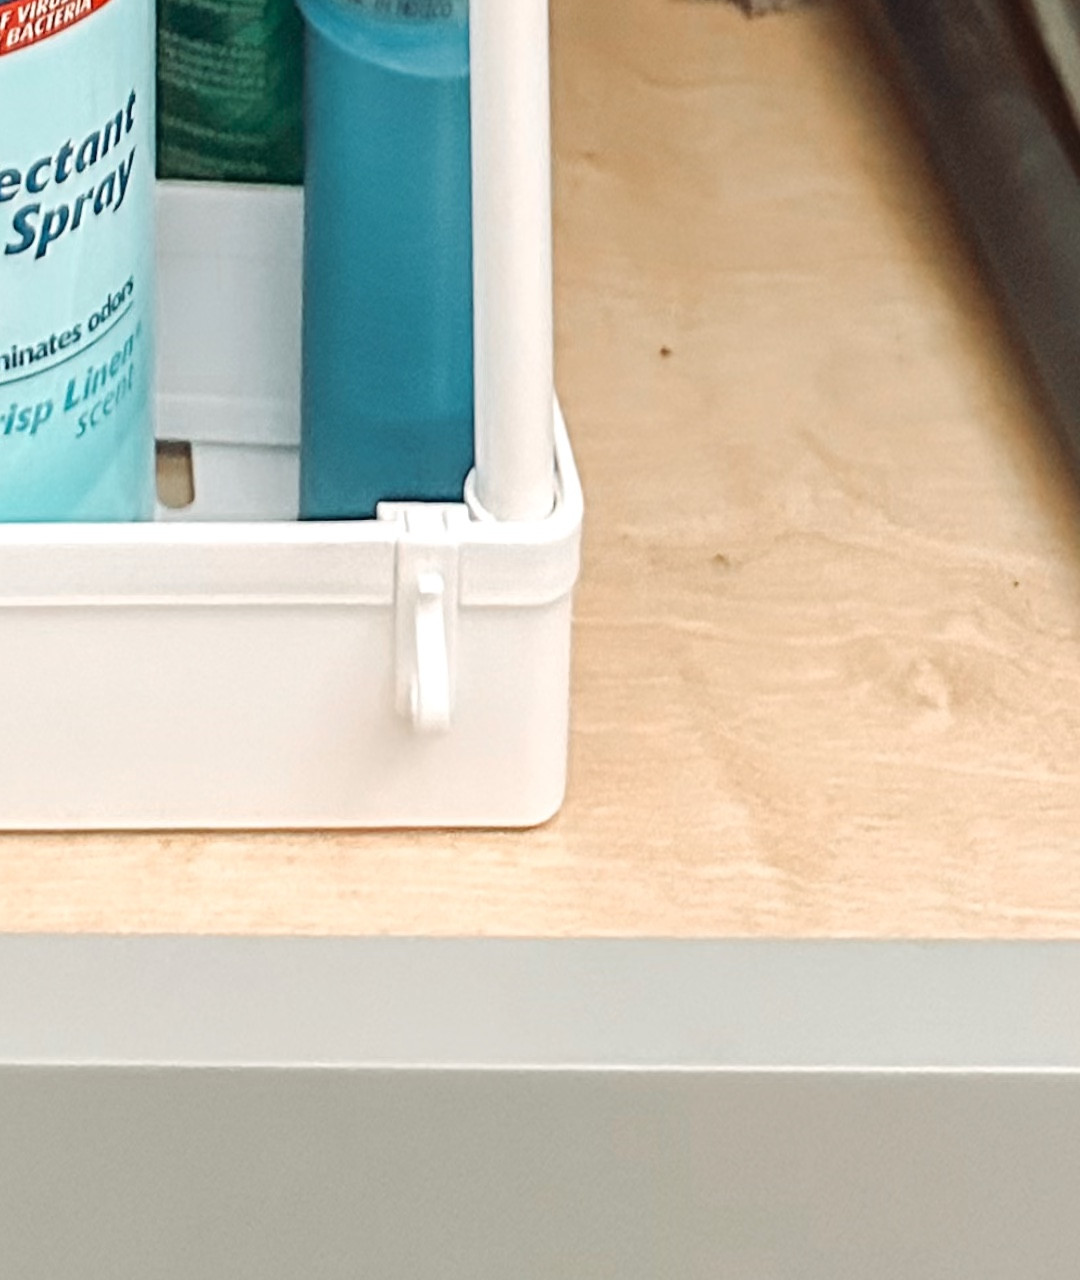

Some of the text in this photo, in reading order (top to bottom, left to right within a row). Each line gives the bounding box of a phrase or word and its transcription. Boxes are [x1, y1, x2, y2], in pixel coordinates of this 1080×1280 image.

[4, 145, 137, 260] Spray
[88, 274, 135, 333] odors
[75, 365, 135, 439] scent
